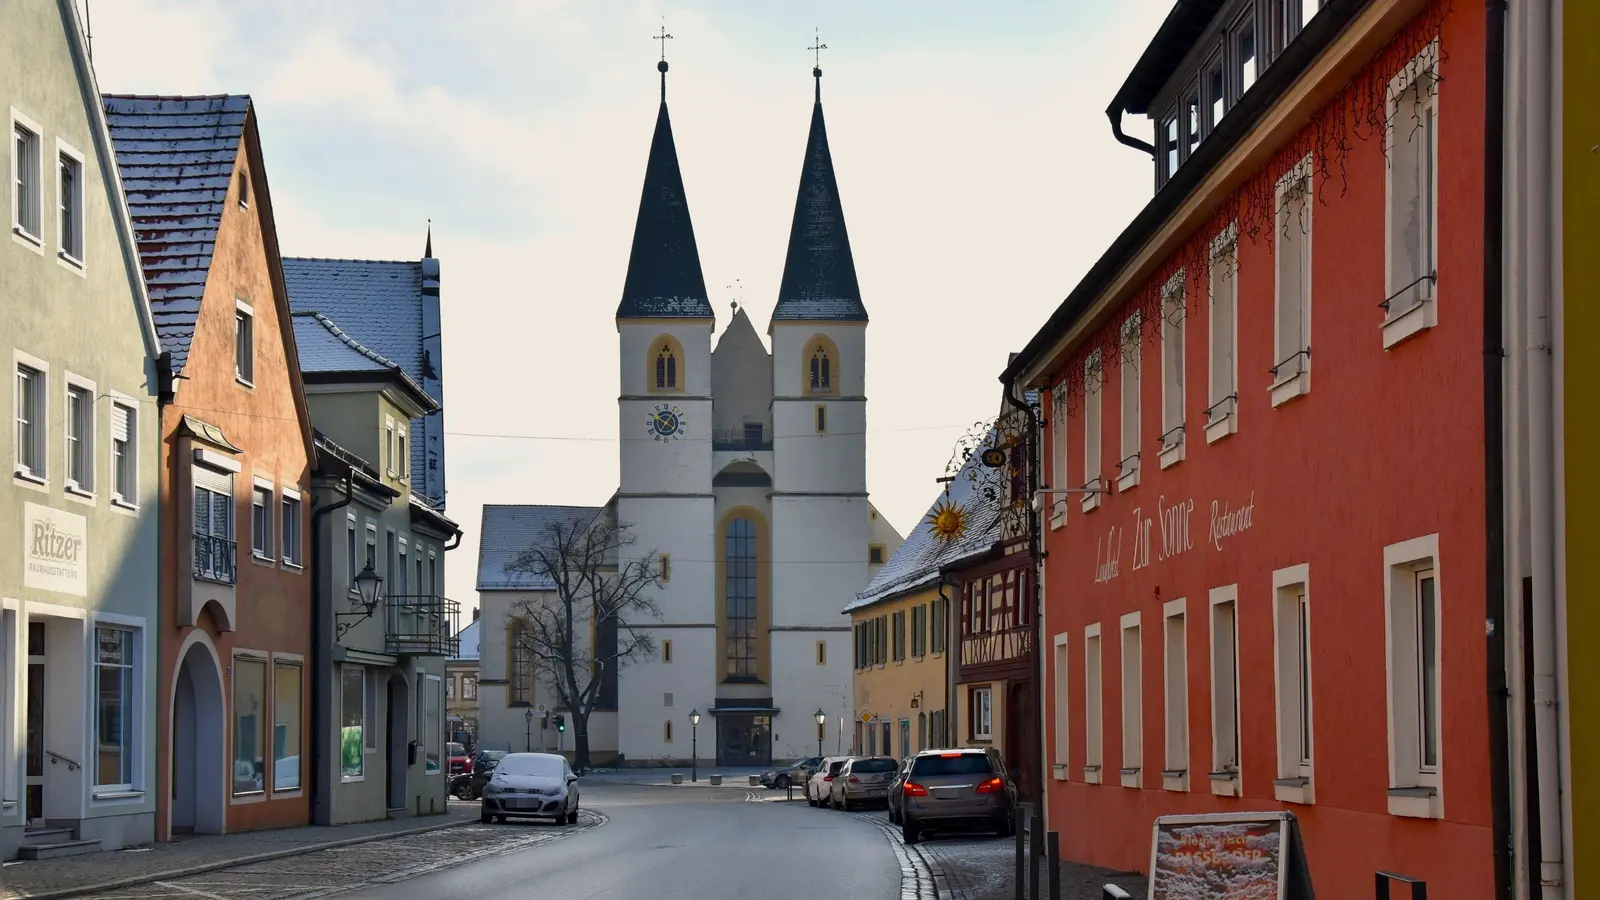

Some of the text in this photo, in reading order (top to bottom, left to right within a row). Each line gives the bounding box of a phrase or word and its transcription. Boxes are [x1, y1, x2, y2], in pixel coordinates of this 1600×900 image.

[31, 522, 82, 562] Ritzer
[1158, 495, 1194, 561] Sonne
[1208, 490, 1255, 552] Restaurant
